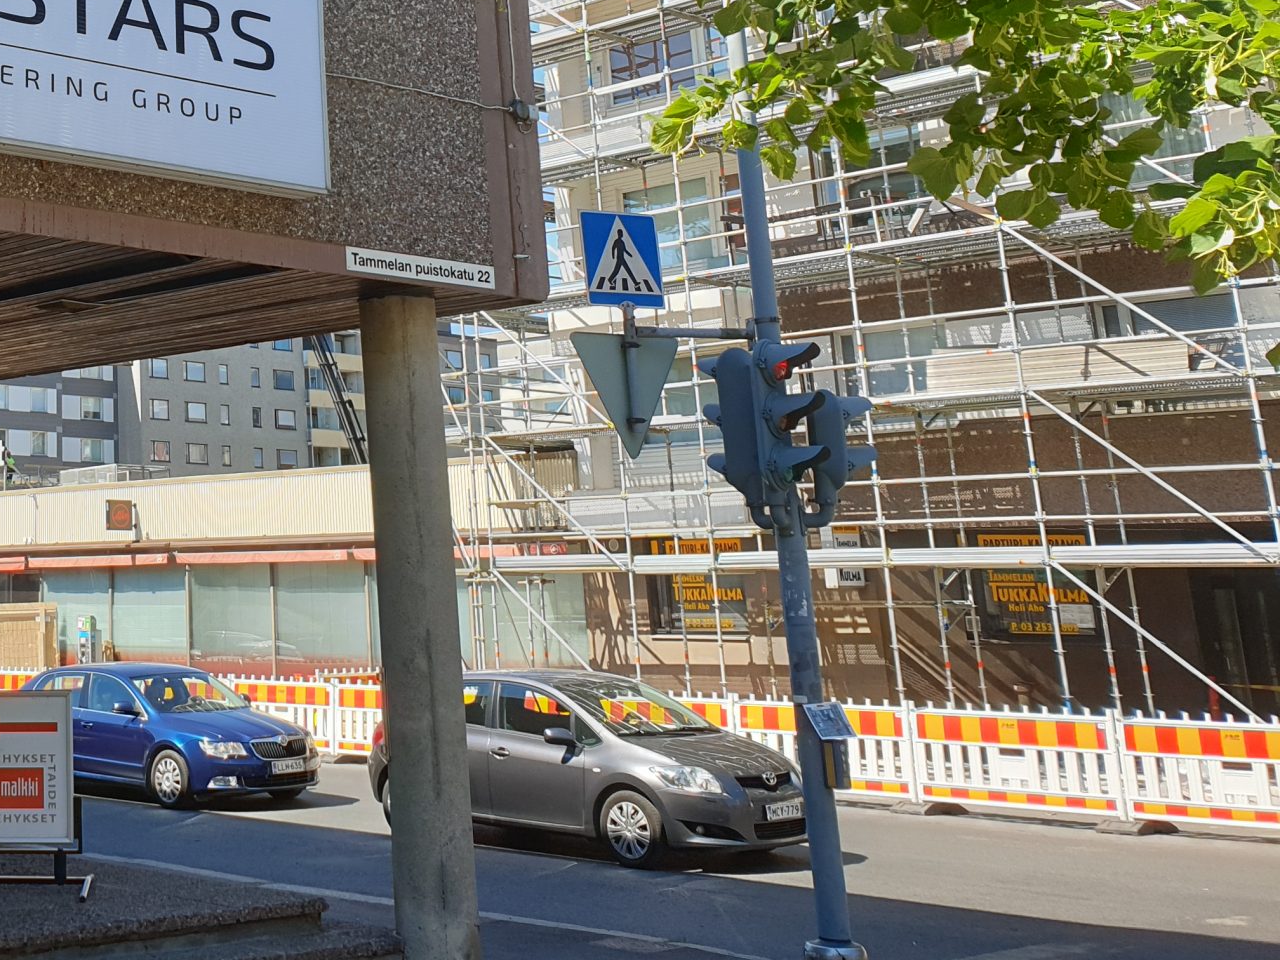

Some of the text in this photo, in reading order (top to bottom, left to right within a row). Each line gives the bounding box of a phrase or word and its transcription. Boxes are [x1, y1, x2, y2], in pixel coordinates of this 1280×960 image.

[132, 89, 243, 125] GROUP
[351, 252, 491, 284] Tammelan puistokatu 22
[982, 539, 1081, 547] PARTURI-KAPAAMO
[0, 777, 38, 797] malkki
[48, 764, 57, 810] TAIDE
